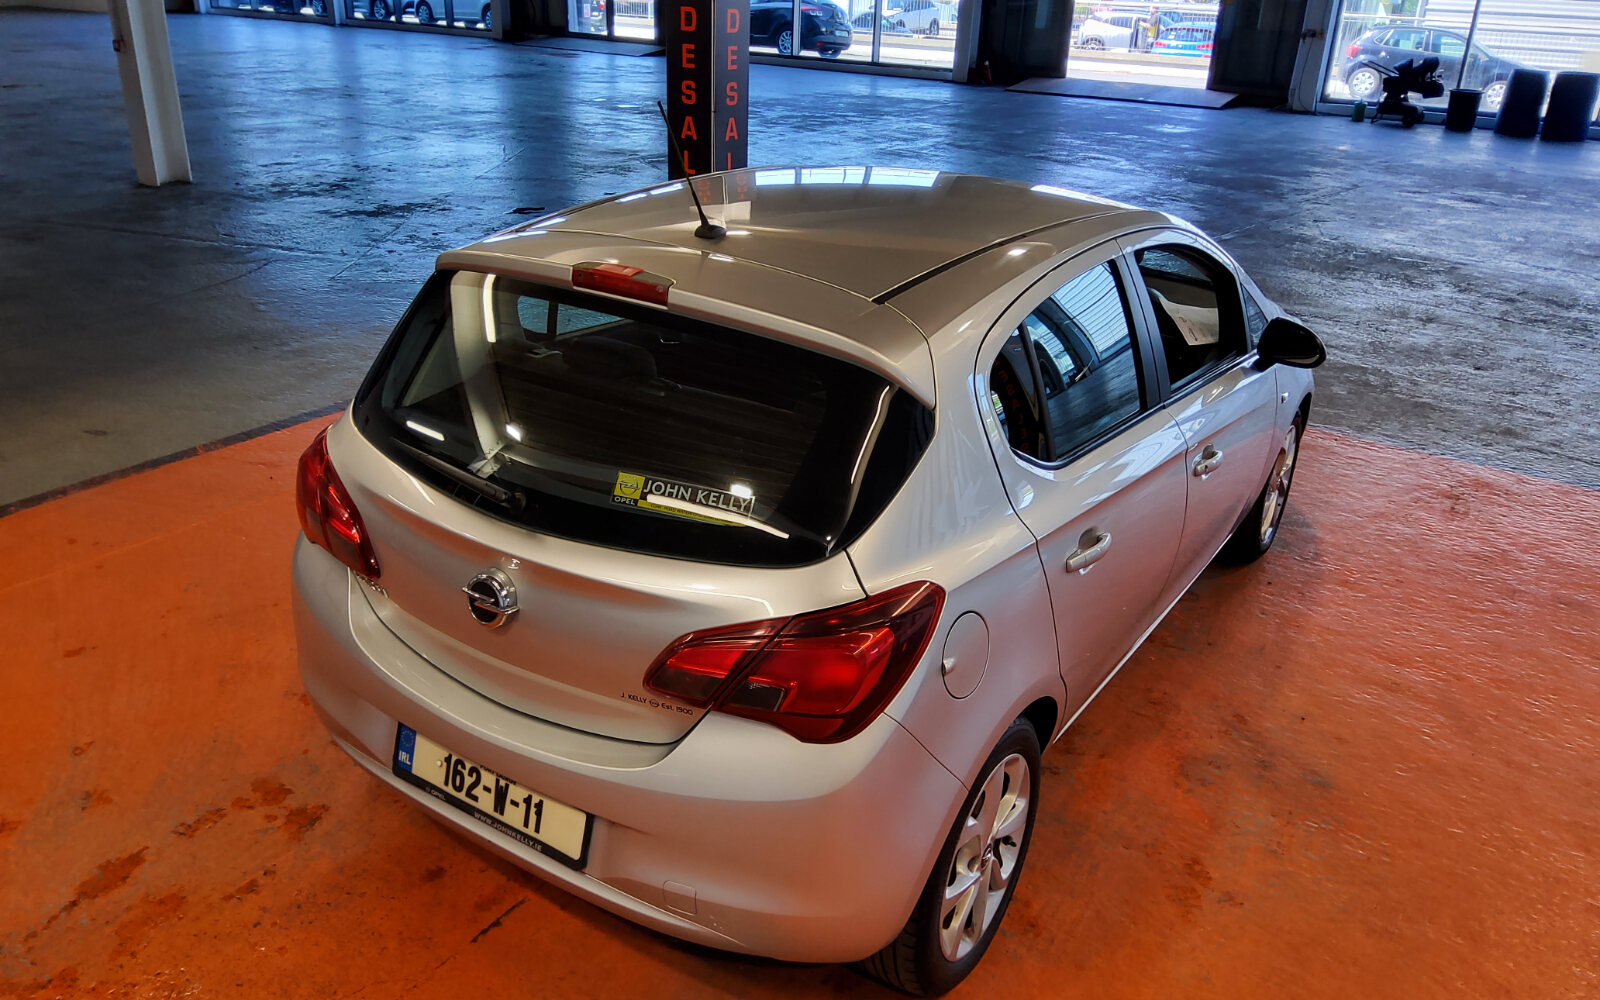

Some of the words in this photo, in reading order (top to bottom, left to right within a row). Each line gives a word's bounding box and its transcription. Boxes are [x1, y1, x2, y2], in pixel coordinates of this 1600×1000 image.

[614, 496, 636, 506] OPEL
[643, 480, 692, 500] JOHN
[696, 489, 750, 512] KELLY
[628, 694, 647, 704] KELLY
[676, 706, 694, 716] 1900
[398, 750, 412, 766] IRL
[444, 753, 544, 834] 162-W-11
